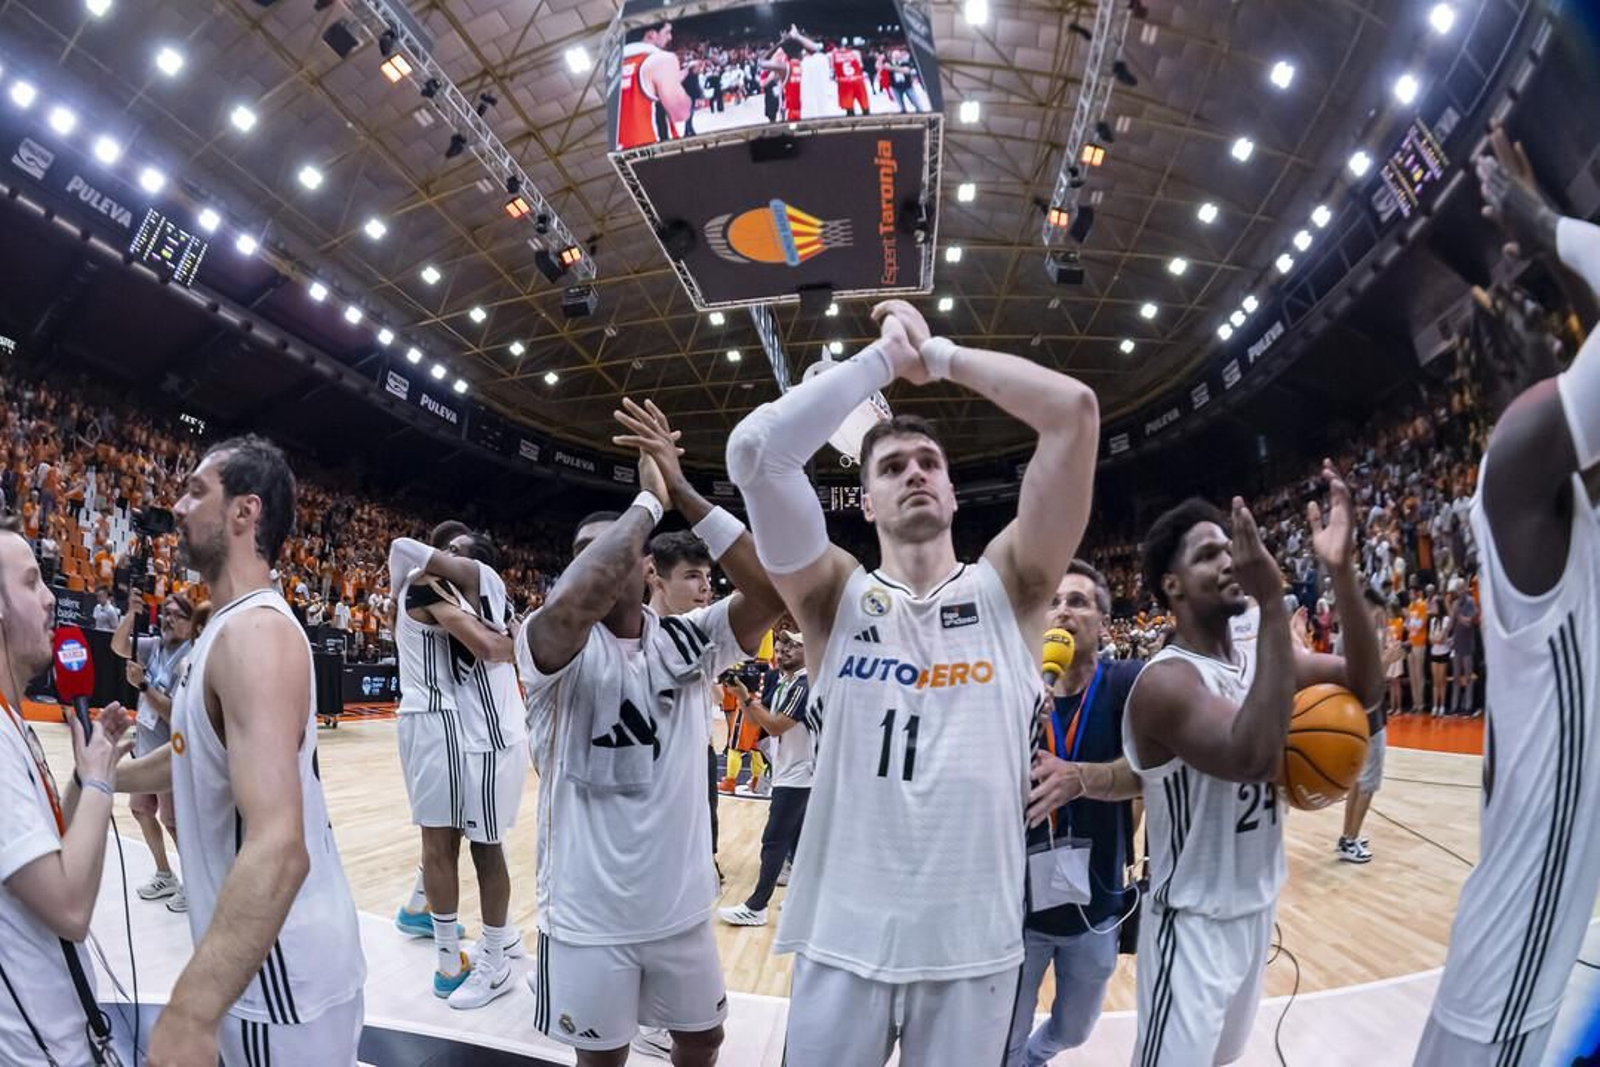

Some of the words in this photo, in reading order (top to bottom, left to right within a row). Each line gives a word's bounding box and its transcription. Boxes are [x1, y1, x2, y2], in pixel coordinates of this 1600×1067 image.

[66, 174, 132, 228] PULEVA
[874, 140, 897, 235] Taronja
[420, 393, 457, 424] PULEVA
[554, 451, 595, 473] PULEVA
[877, 709, 920, 781] 11
